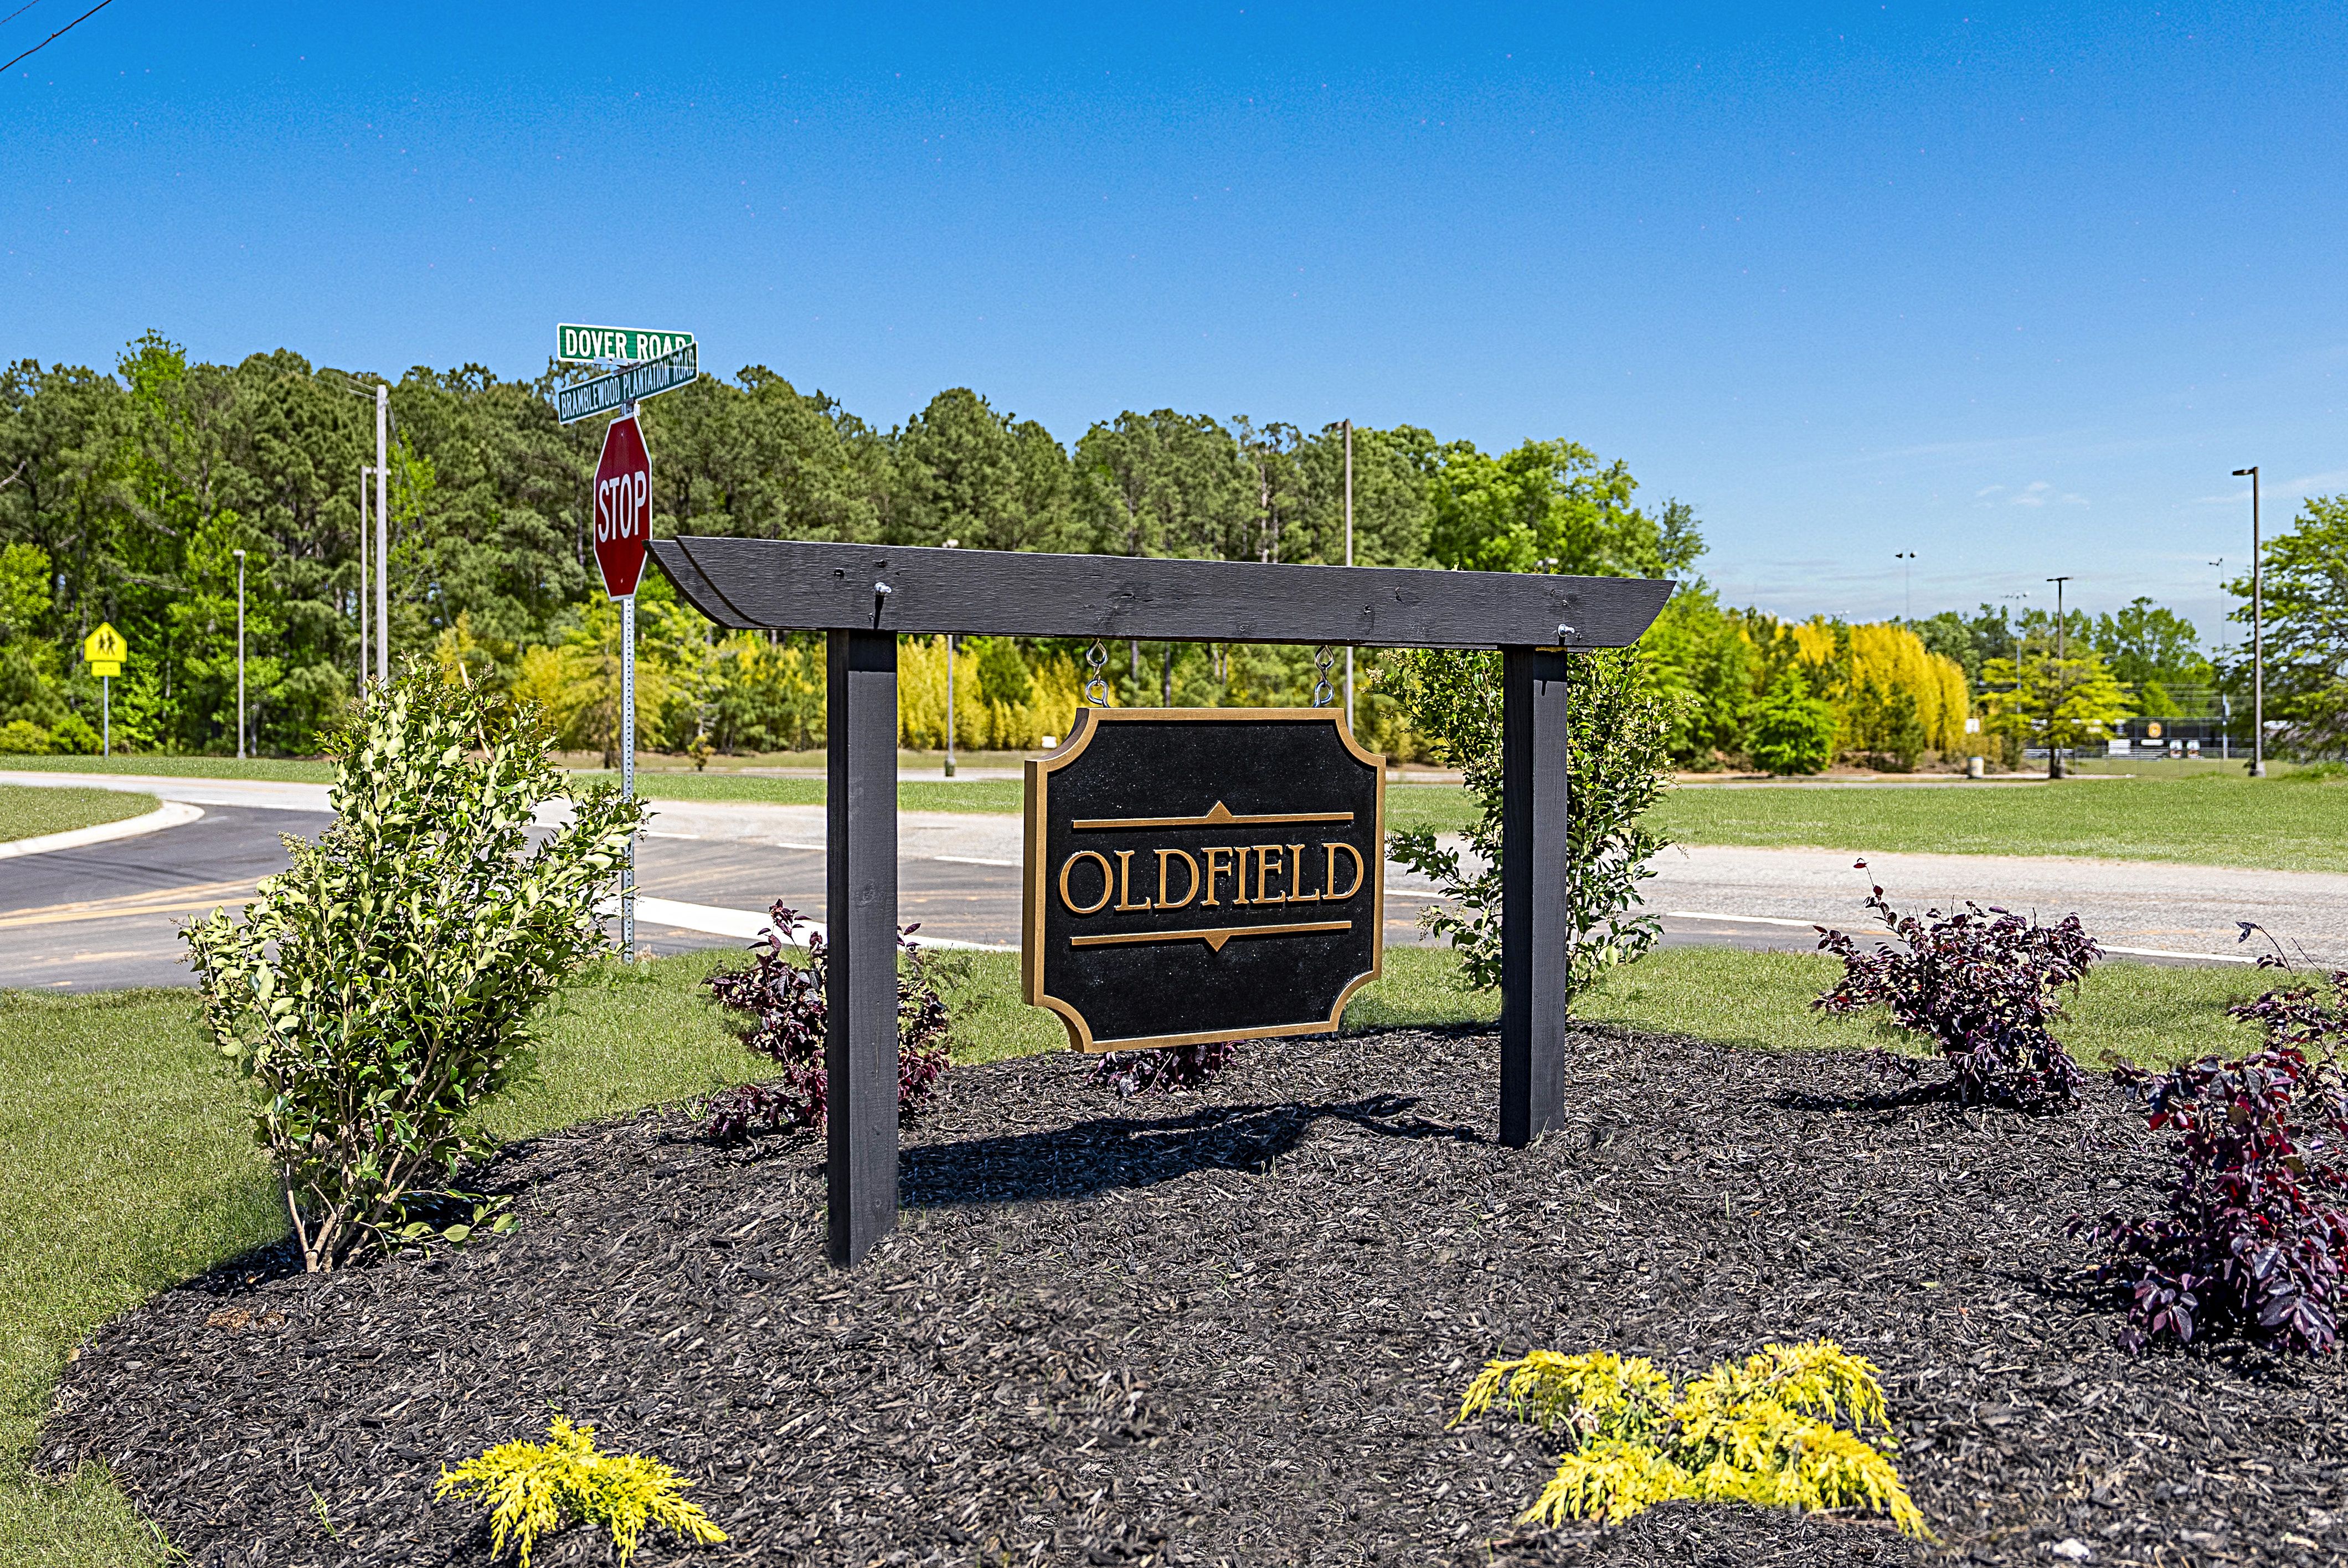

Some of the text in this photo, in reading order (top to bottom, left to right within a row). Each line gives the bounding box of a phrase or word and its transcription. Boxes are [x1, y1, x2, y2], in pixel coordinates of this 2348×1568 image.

[565, 328, 627, 359] DOVER
[561, 349, 695, 419] BRAMBLEWOOD PLANTATION ROAD
[598, 471, 646, 543] STOP
[1059, 842, 1364, 914] OLDFIELD
